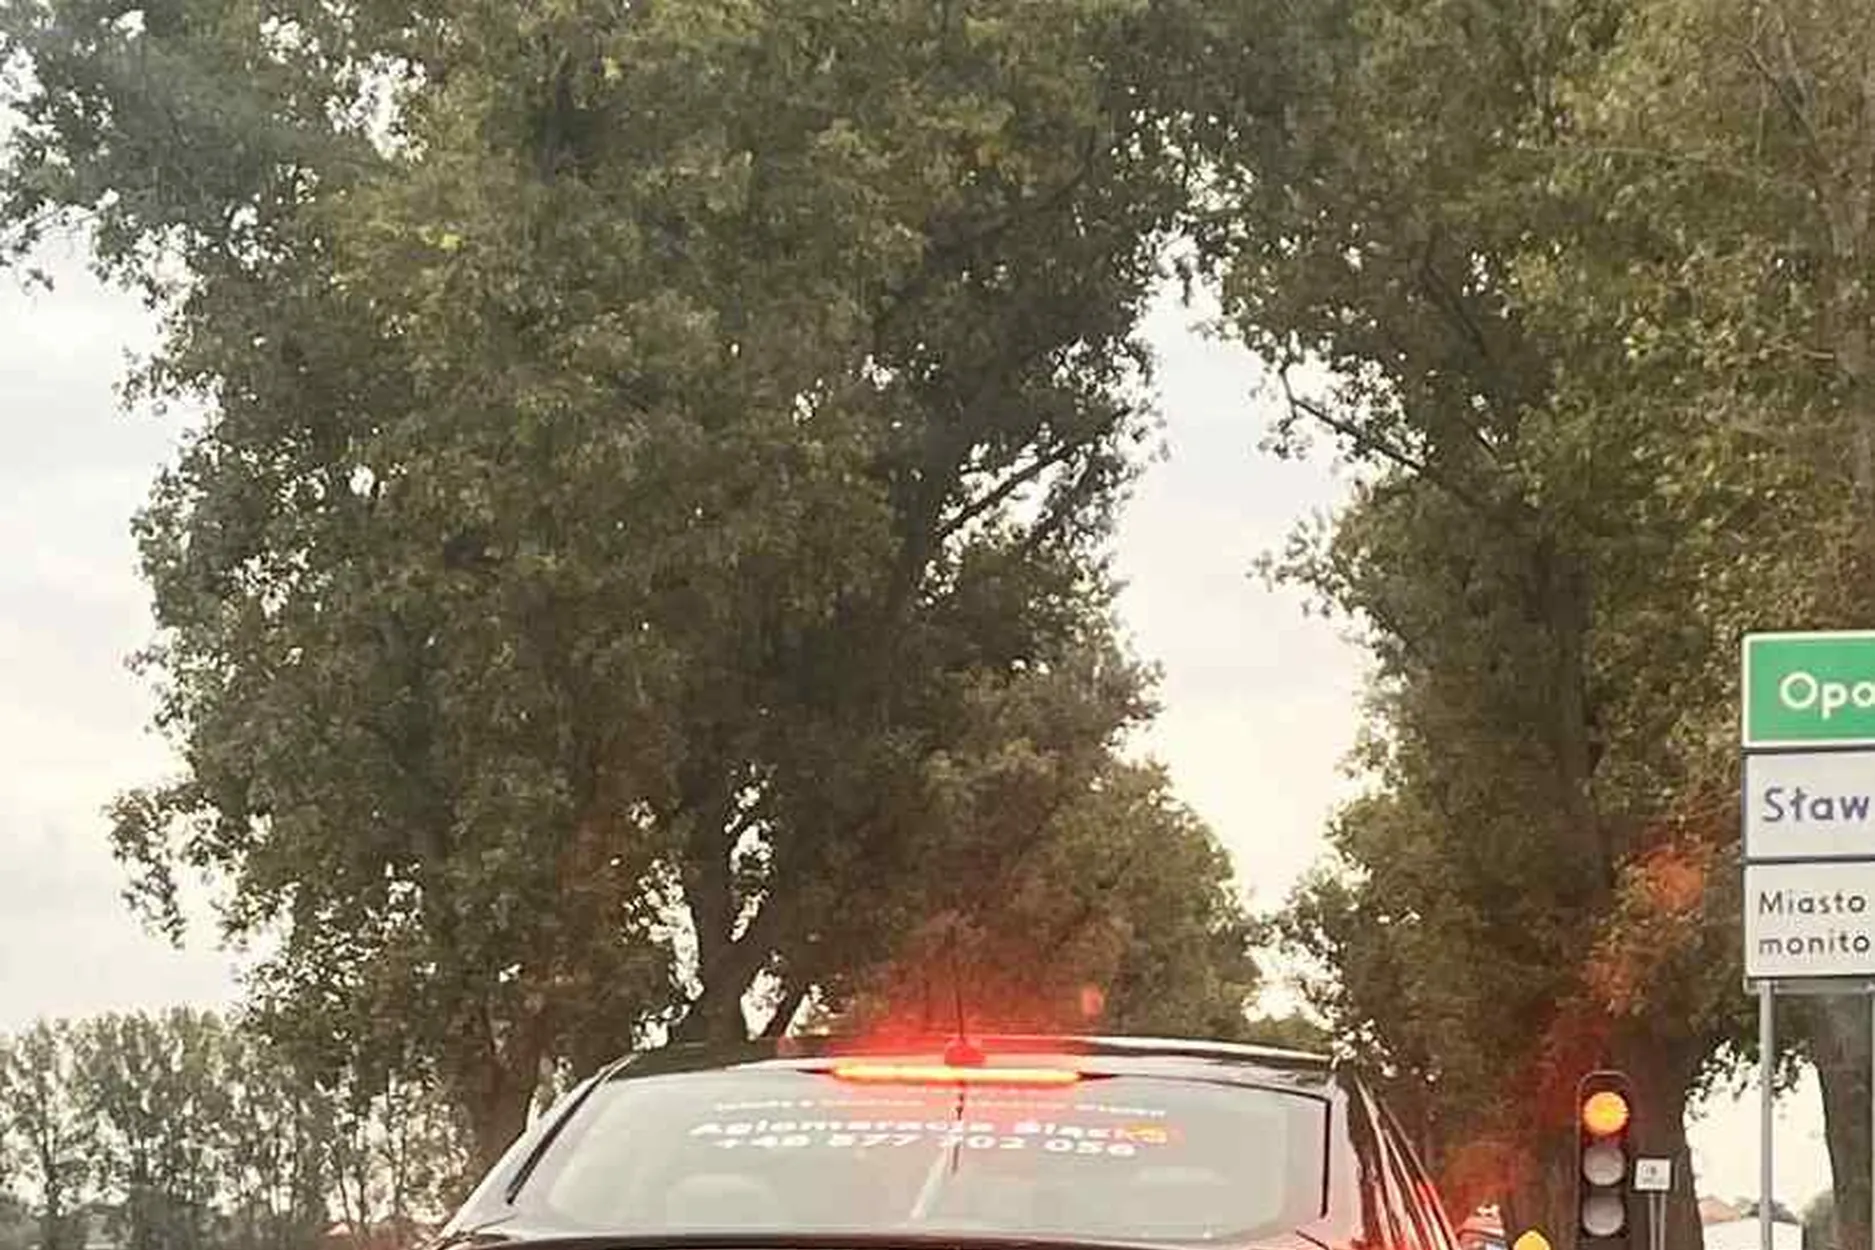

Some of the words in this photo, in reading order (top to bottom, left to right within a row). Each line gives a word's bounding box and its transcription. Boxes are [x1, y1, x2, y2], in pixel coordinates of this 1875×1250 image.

[1762, 786, 1870, 822] Sław
[1759, 891, 1867, 914] Miasto
[1759, 929, 1872, 955] monito
